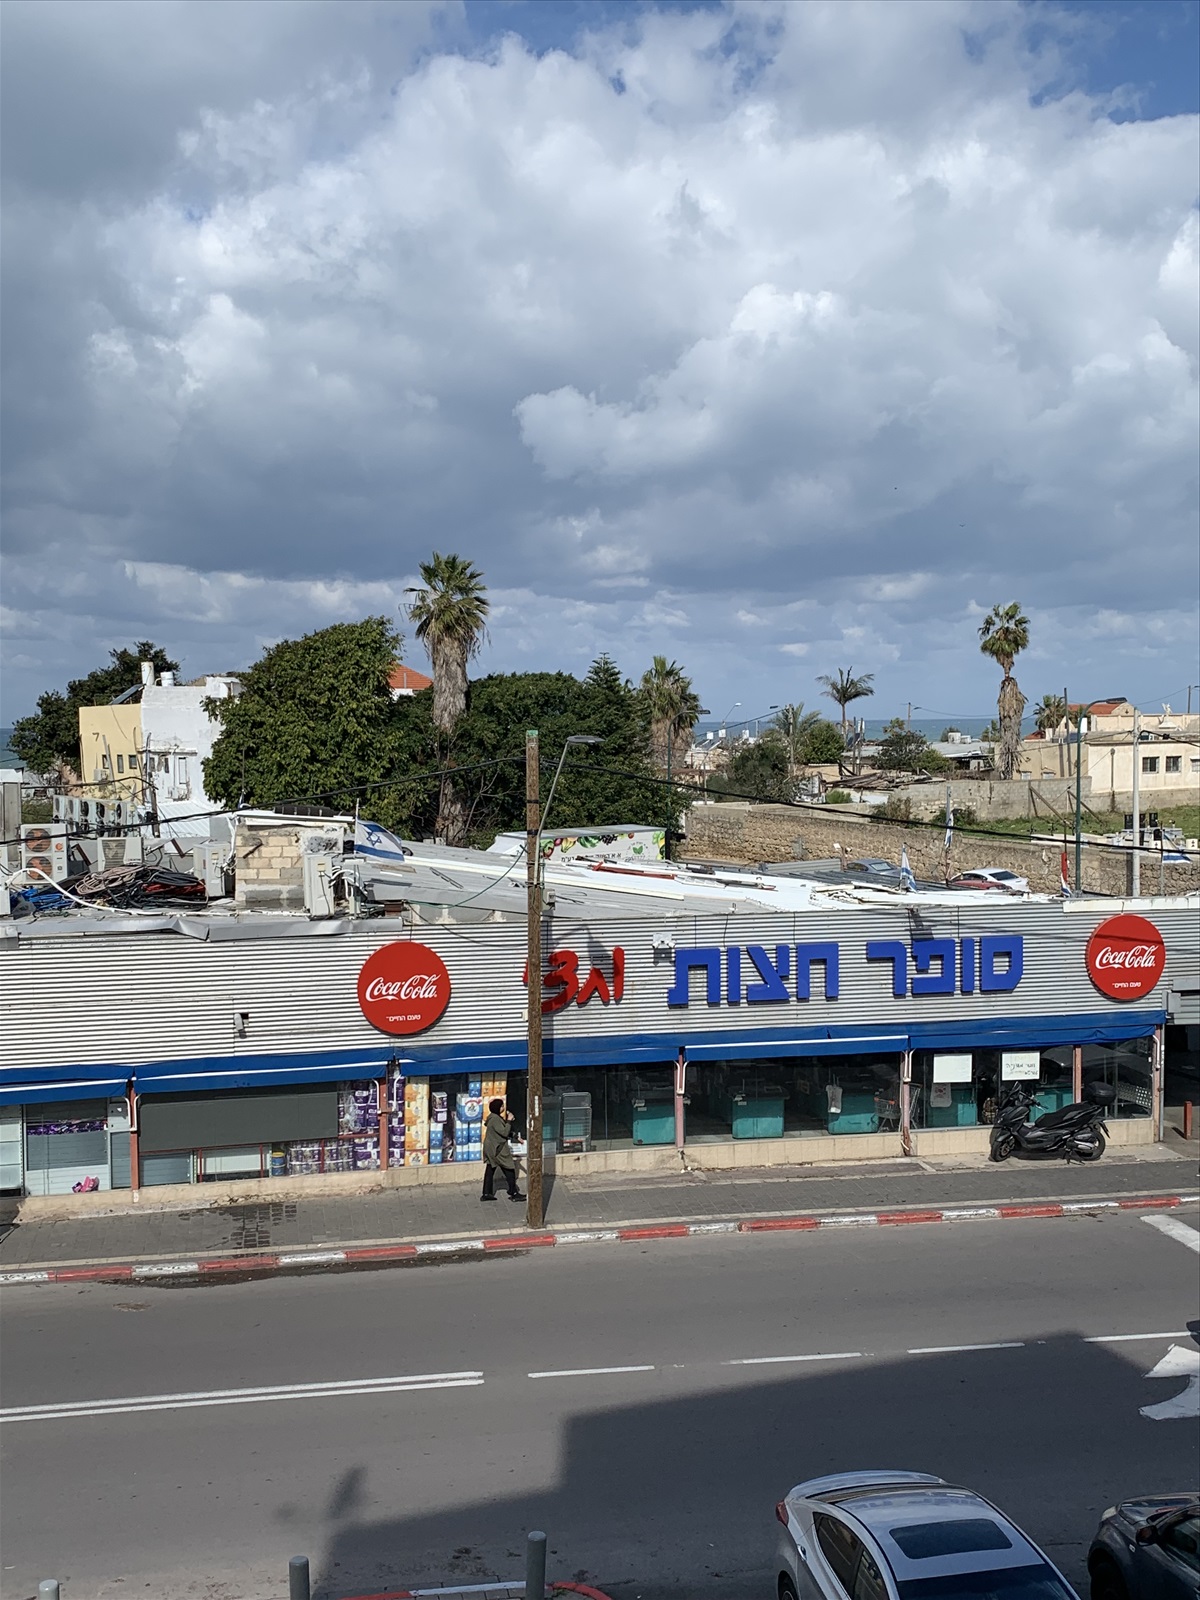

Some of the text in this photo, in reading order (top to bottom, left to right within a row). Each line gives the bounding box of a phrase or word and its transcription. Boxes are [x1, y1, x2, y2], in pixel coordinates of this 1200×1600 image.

[668, 943, 839, 1006] חצות
[866, 936, 1024, 997] סופר
[1095, 945, 1159, 969] Coca-Cola
[365, 974, 441, 1002] Coca-Cola
